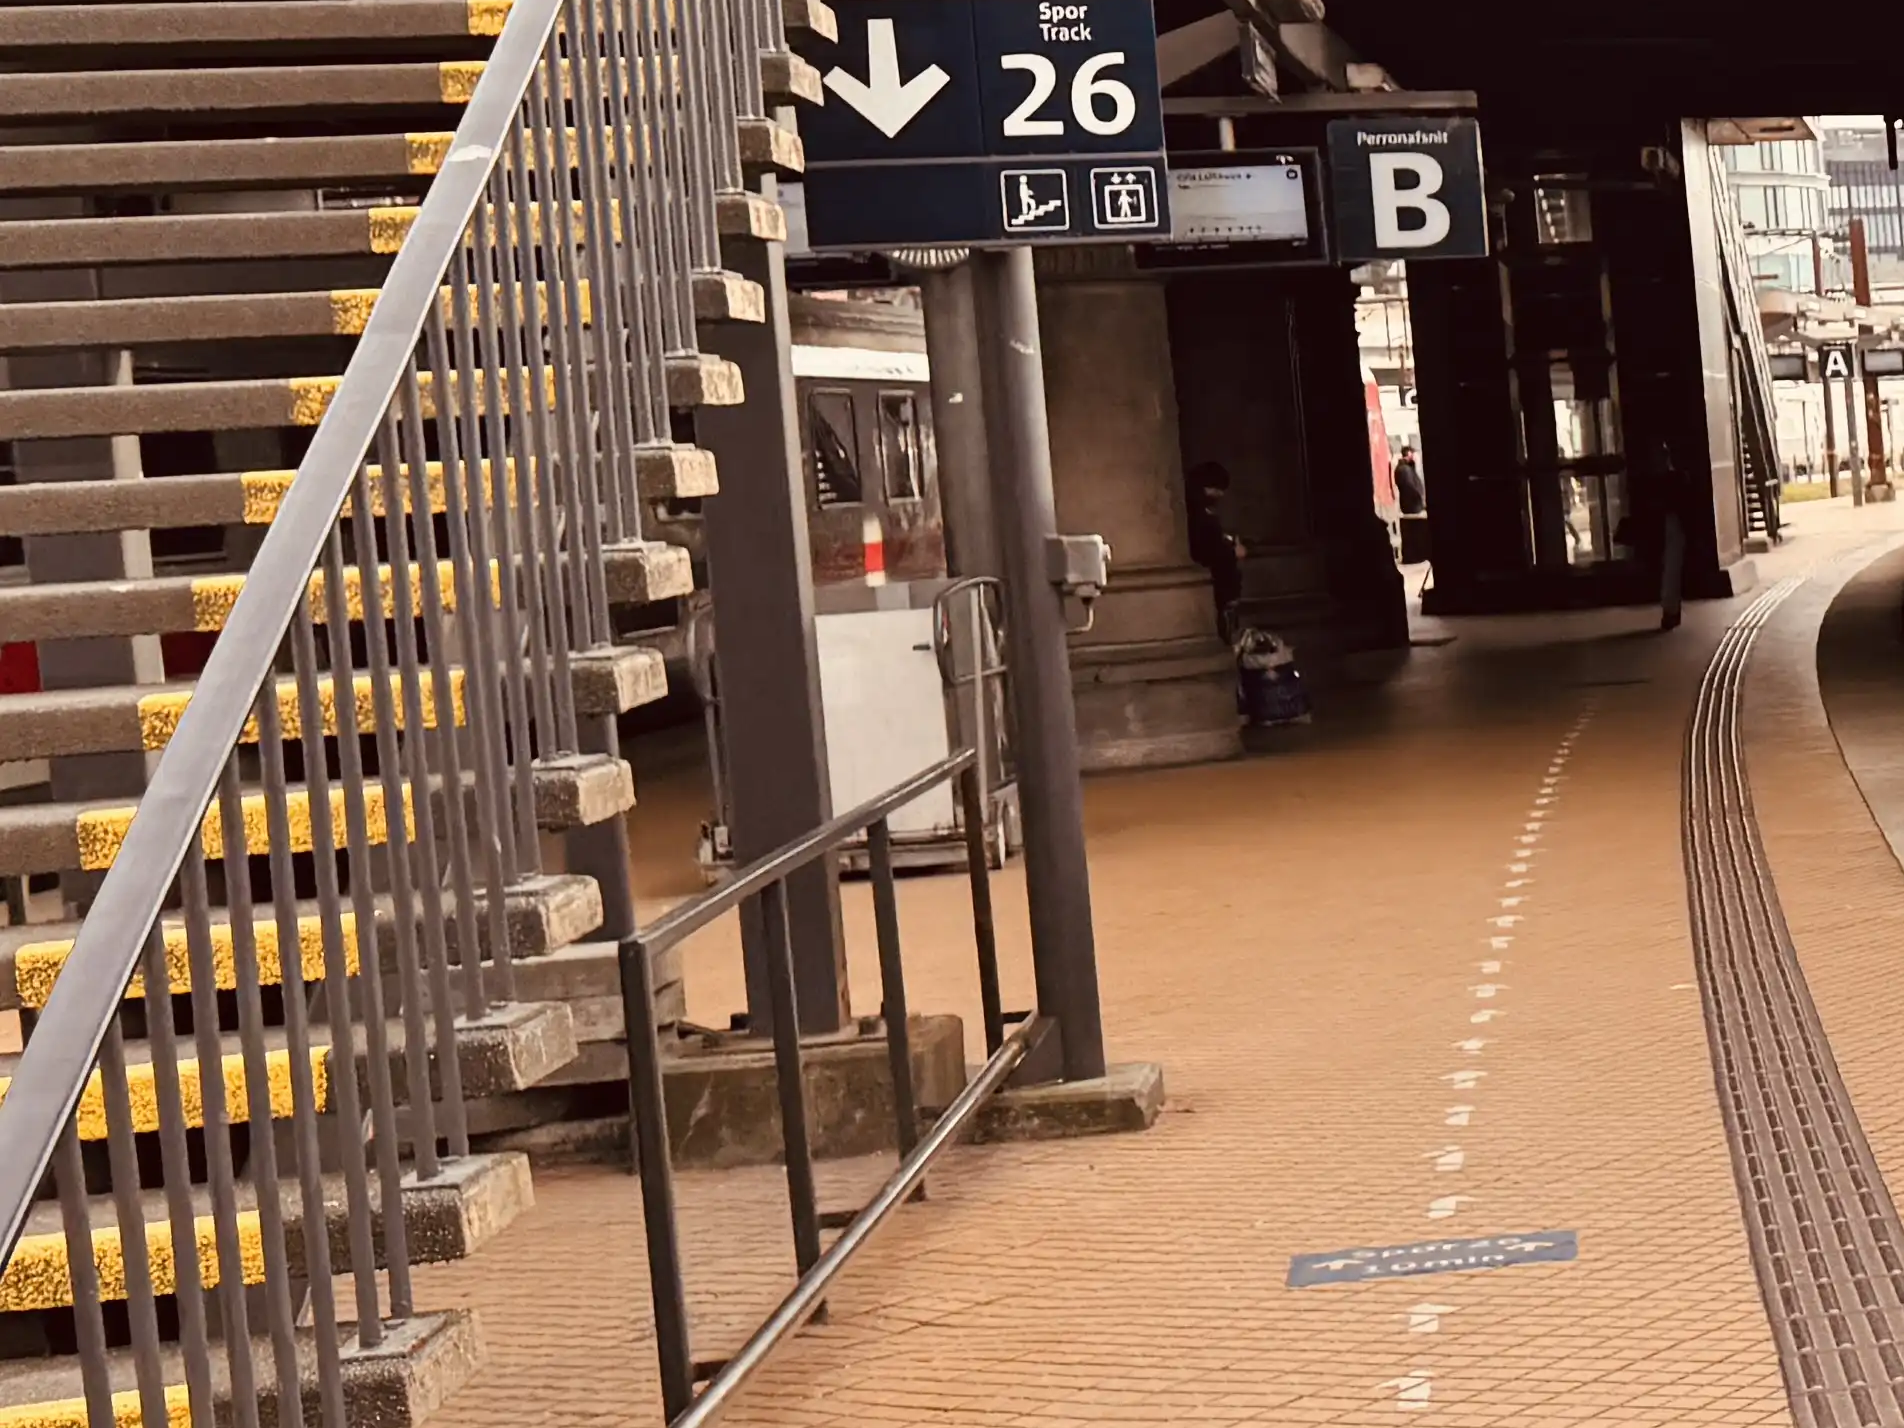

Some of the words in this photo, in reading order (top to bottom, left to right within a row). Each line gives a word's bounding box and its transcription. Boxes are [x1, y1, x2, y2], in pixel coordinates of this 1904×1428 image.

[1038, 1, 1088, 23] Spor
[1039, 23, 1092, 42] Track
[1001, 51, 1136, 137] 26
[1356, 130, 1449, 147] Perronafsnit
[1369, 151, 1451, 249] B
[1825, 350, 1849, 377] A
